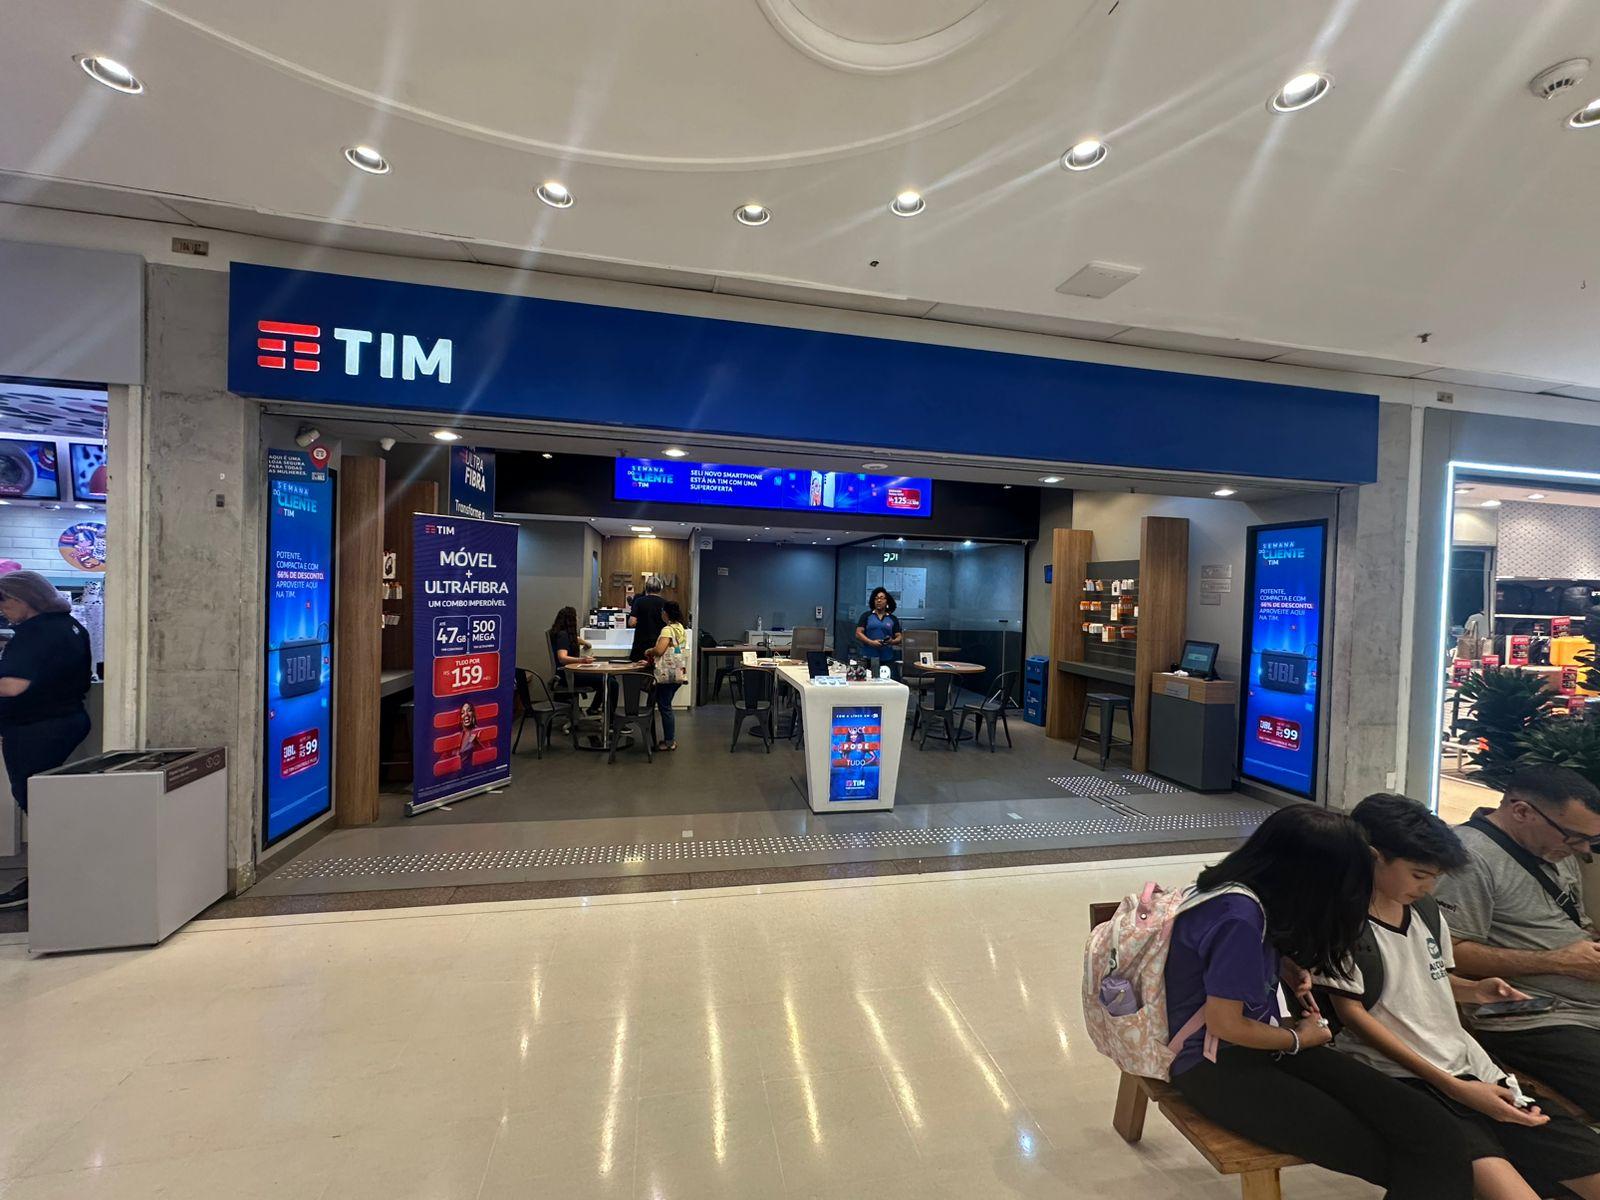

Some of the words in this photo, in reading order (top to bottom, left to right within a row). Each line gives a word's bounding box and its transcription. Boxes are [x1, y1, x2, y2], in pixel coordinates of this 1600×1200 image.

[334, 327, 452, 384] TIM
[632, 465, 664, 473] SEMANA
[465, 466, 486, 492] FIBRA
[632, 472, 674, 484] CLIENTE
[690, 476, 706, 484] ESTÁ
[705, 470, 722, 478] NOVO
[723, 471, 763, 481] SMARTPHONE
[277, 481, 309, 495] SEMANA
[690, 484, 733, 492] SUPEROFERTA
[278, 492, 317, 513] CLIENTE
[284, 508, 295, 518] TIM
[455, 498, 483, 519] Transforme
[436, 526, 455, 535] TIM
[1263, 541, 1295, 549] SEMANA
[276, 551, 302, 561] POTENTE,
[439, 547, 497, 568] MÓVEL
[1263, 549, 1305, 559] CLIENTE
[276, 561, 304, 570] COMPACTA
[307, 563, 319, 571] COM
[277, 571, 289, 579] 66%
[289, 571, 297, 579] DE
[276, 580, 304, 590] APROVEITE
[305, 582, 318, 590] AQUI
[425, 580, 509, 594] ULTRAFIBRA
[276, 591, 285, 599] NA
[428, 600, 441, 608] UM
[442, 600, 468, 608] COMBO
[468, 598, 506, 607] IMPERDÍVEL
[472, 620, 496, 633] 500
[472, 633, 496, 642] MEGA
[286, 655, 316, 684] JBL
[1267, 661, 1299, 684] JBL
[451, 665, 483, 688] 159
[1283, 728, 1298, 740] 99
[283, 744, 296, 758] JBL
[306, 738, 318, 755] 99
[844, 742, 869, 750] PODE
[846, 759, 866, 767] TUDO
[853, 779, 865, 787] TIM
